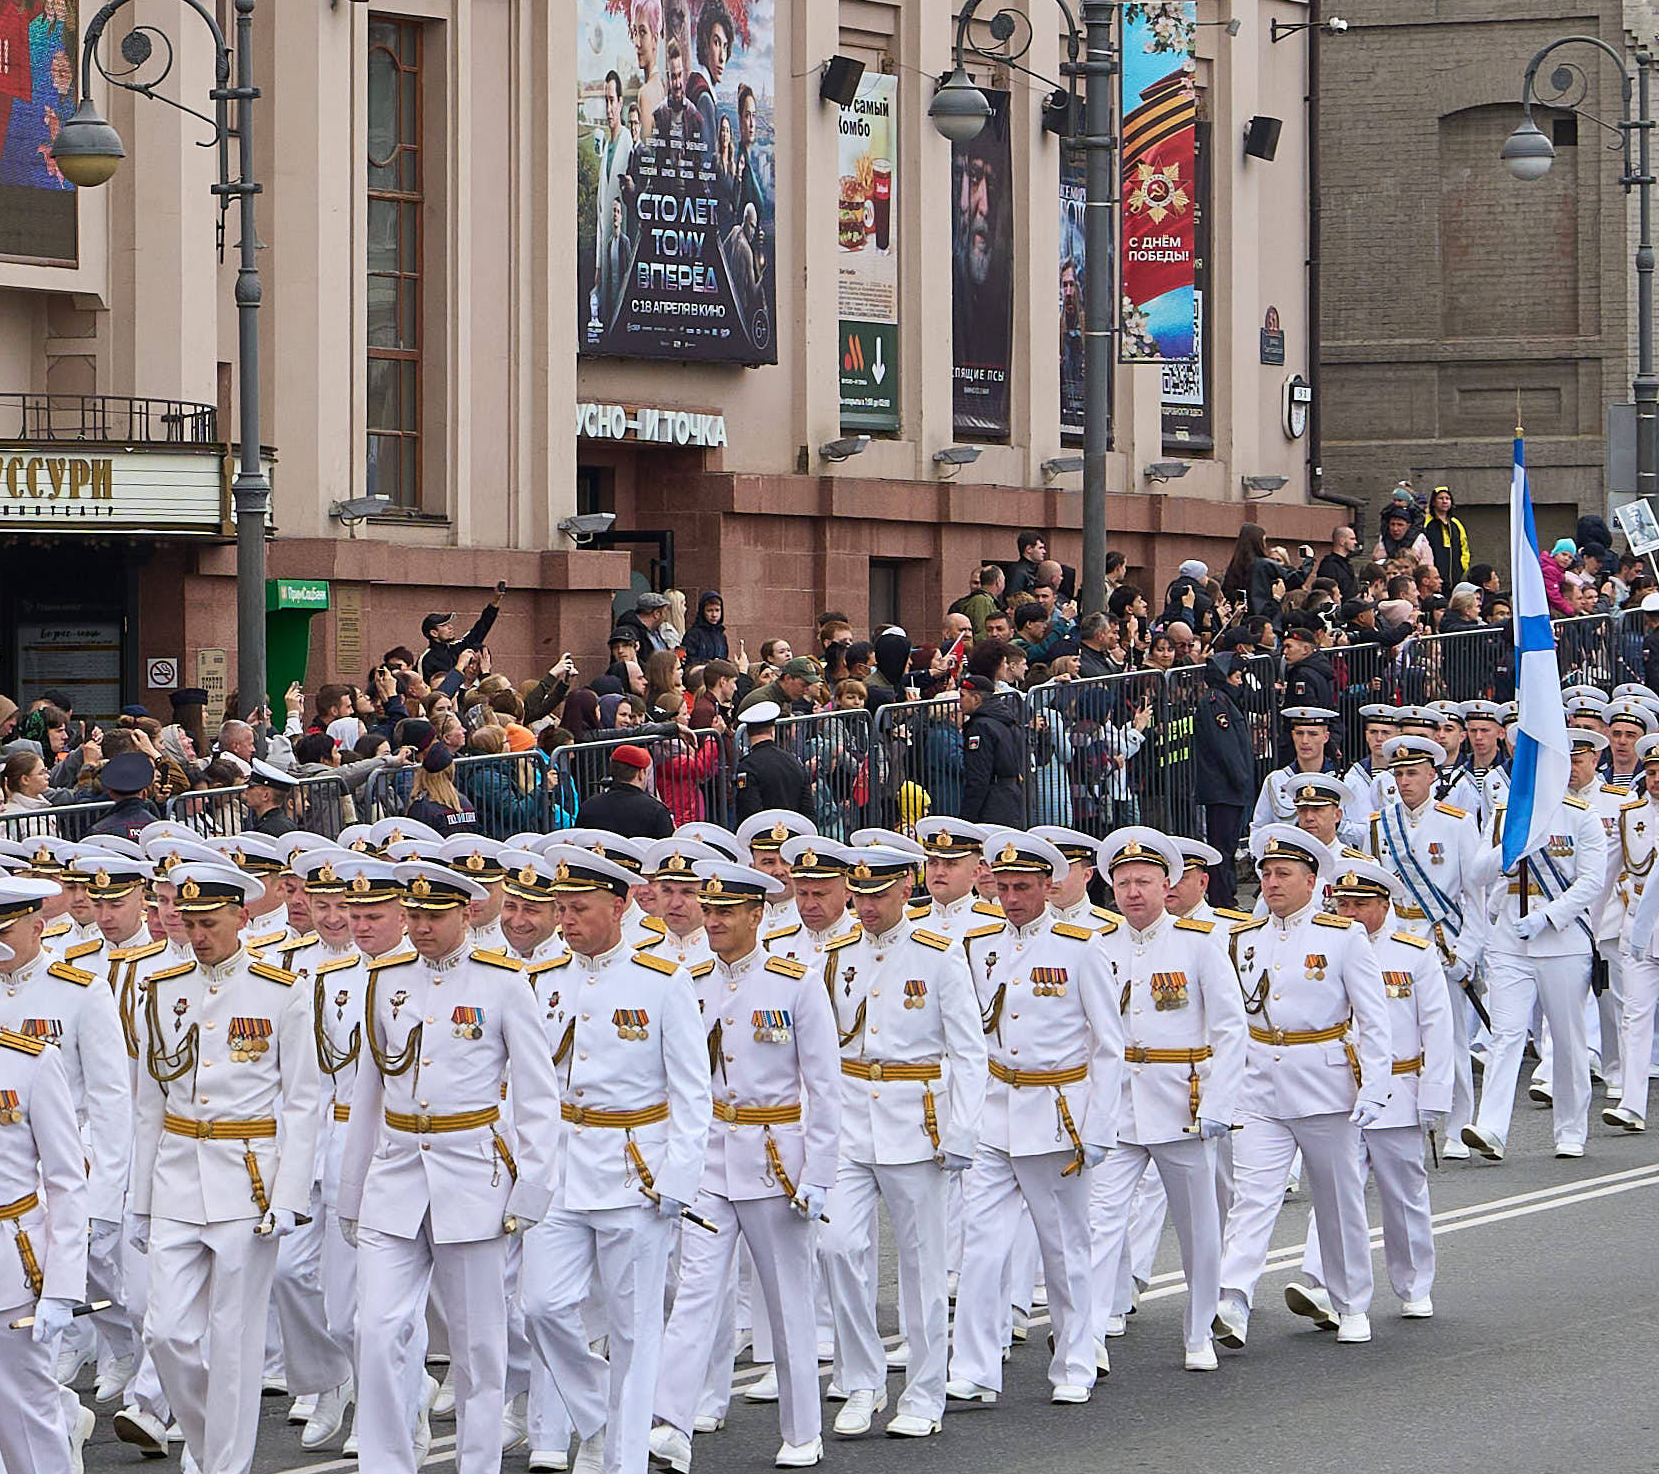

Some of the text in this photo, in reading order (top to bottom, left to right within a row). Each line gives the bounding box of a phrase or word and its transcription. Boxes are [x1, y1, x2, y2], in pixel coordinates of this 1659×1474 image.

[854, 97, 889, 117] самый
[637, 192, 718, 225] СТО ЛЕТ
[651, 228, 705, 258] ТОМУ
[1129, 234, 1181, 249] С ДНЁМ
[1128, 250, 1189, 263] ПОБЕДЫ!
[637, 261, 719, 293] ВПЕРЁД
[653, 301, 691, 316] АПРЕЛЯ
[699, 305, 726, 318] КИНО
[987, 370, 1004, 381] ПСЫ
